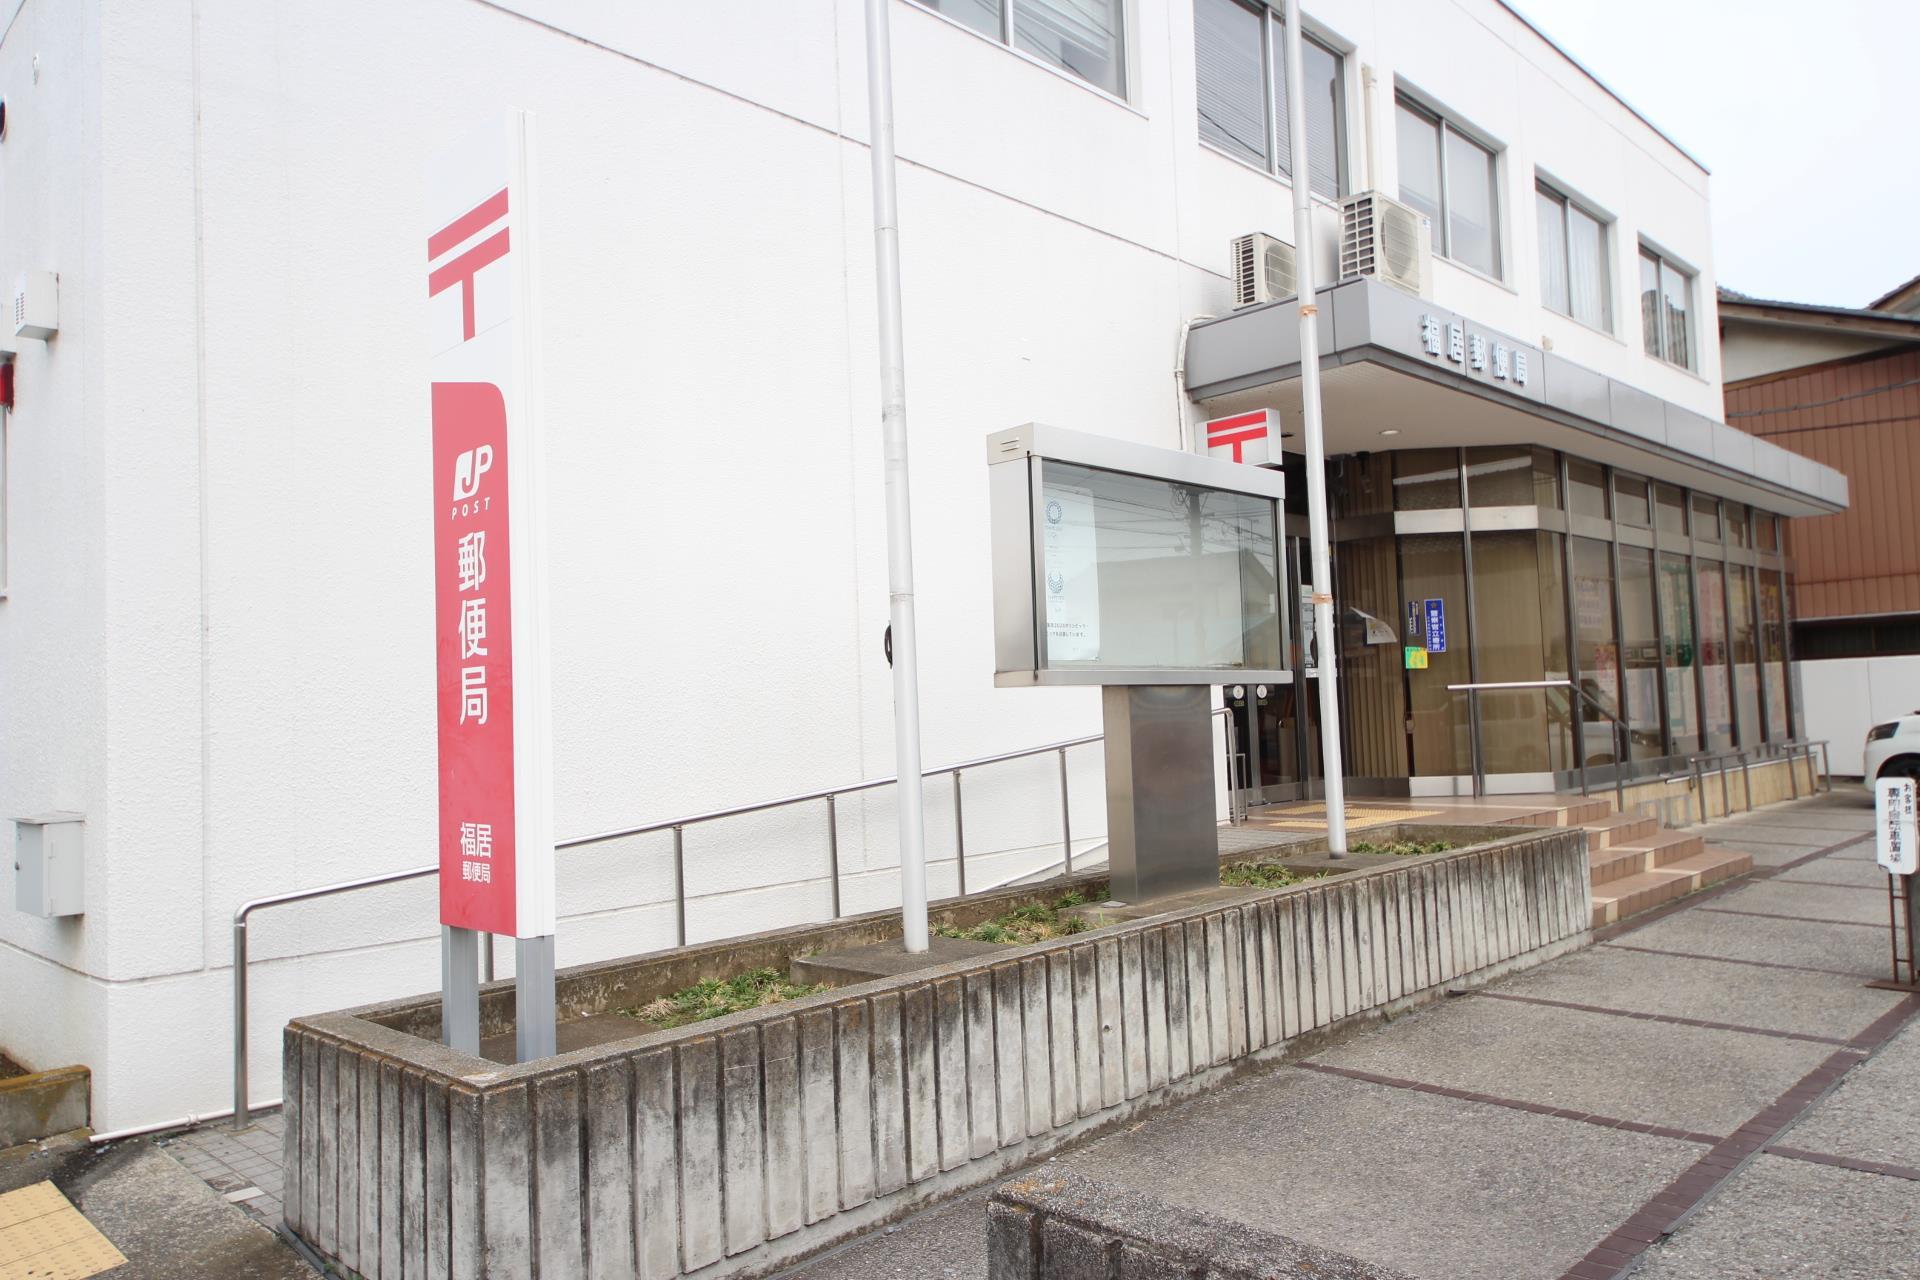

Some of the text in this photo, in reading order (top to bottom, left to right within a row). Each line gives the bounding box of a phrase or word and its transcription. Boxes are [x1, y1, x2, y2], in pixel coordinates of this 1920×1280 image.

[1421, 313, 1528, 386] 福居郵便局
[451, 497, 492, 520] POST
[458, 531, 488, 725] 郵便局
[1904, 783, 1912, 814] お客様
[460, 822, 492, 859] 福居
[462, 860, 491, 884] 郵便局
